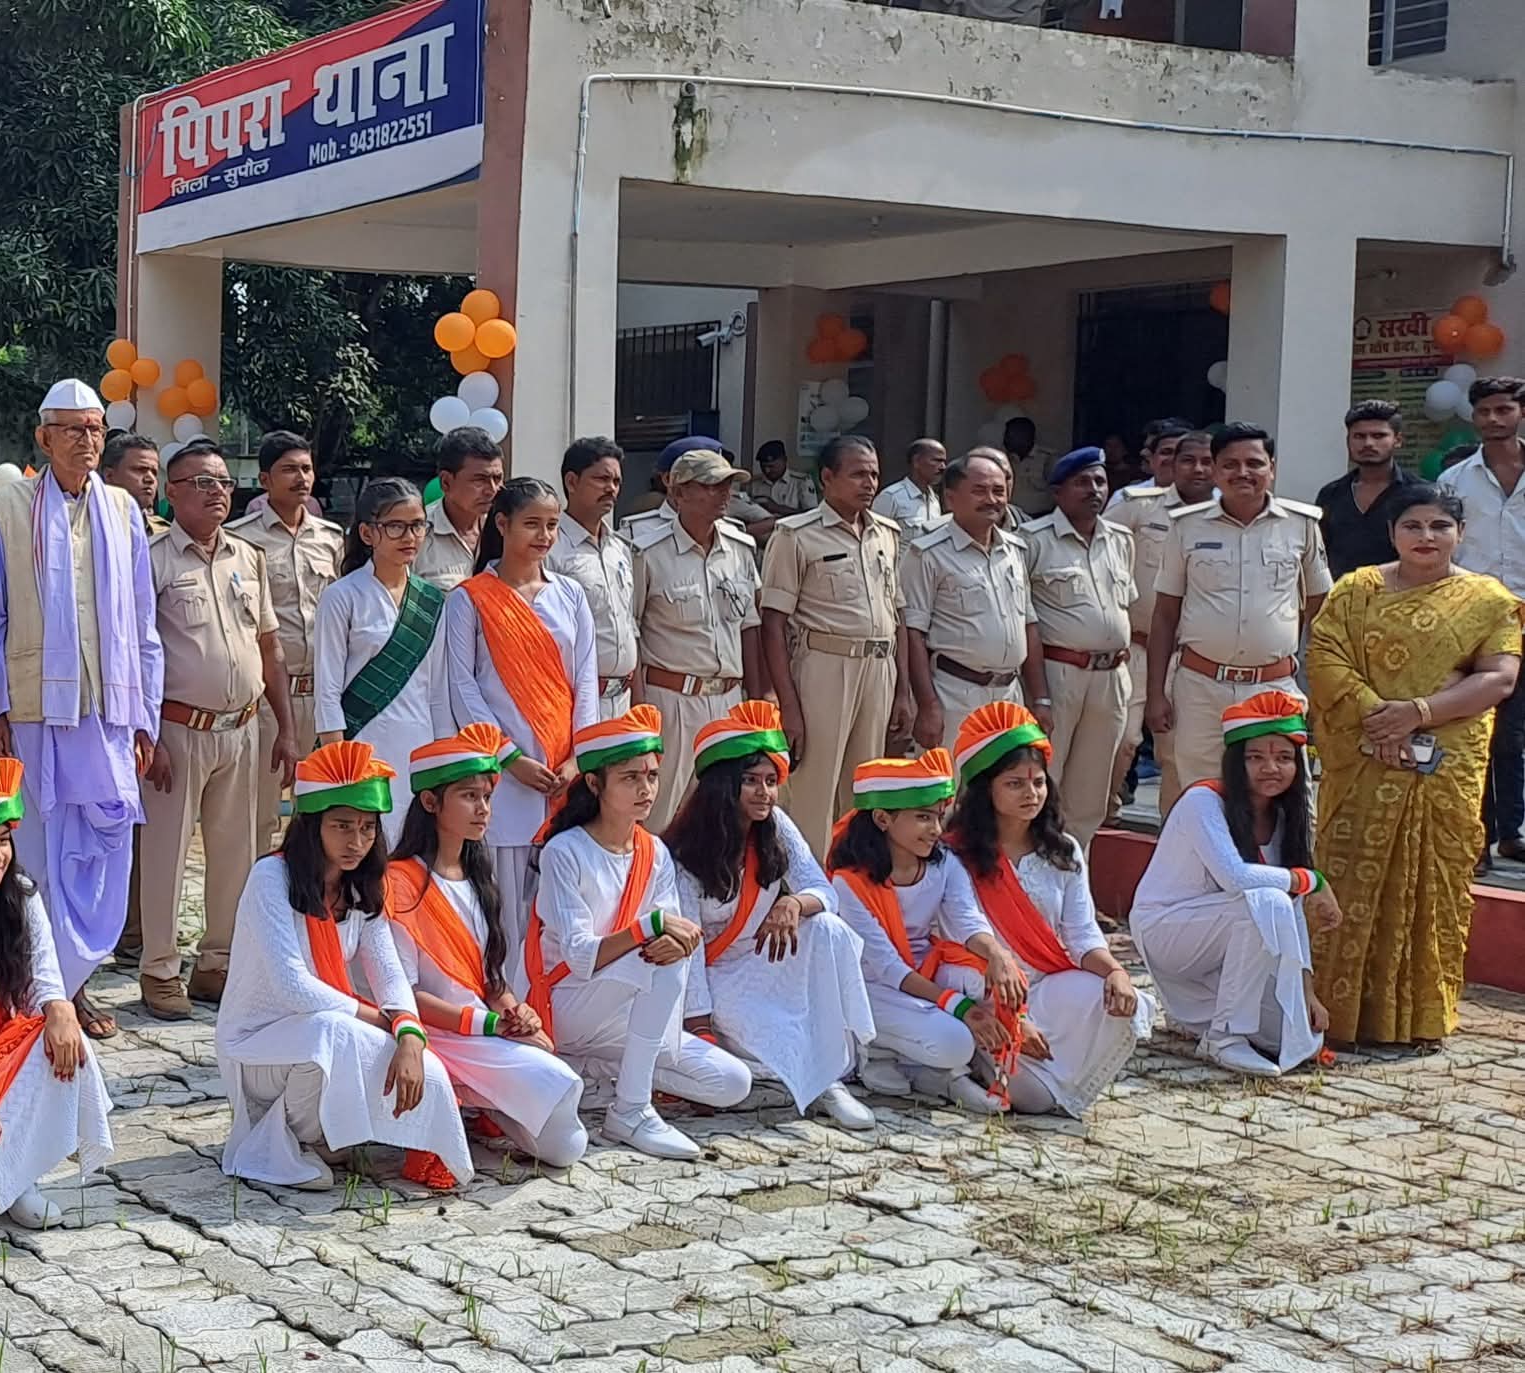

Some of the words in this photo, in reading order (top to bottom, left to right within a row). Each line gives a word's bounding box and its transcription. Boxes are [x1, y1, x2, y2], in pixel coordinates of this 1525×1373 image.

[158, 79, 293, 177] पिपरा
[312, 22, 455, 128] थाना
[349, 110, 432, 154] 9431822551
